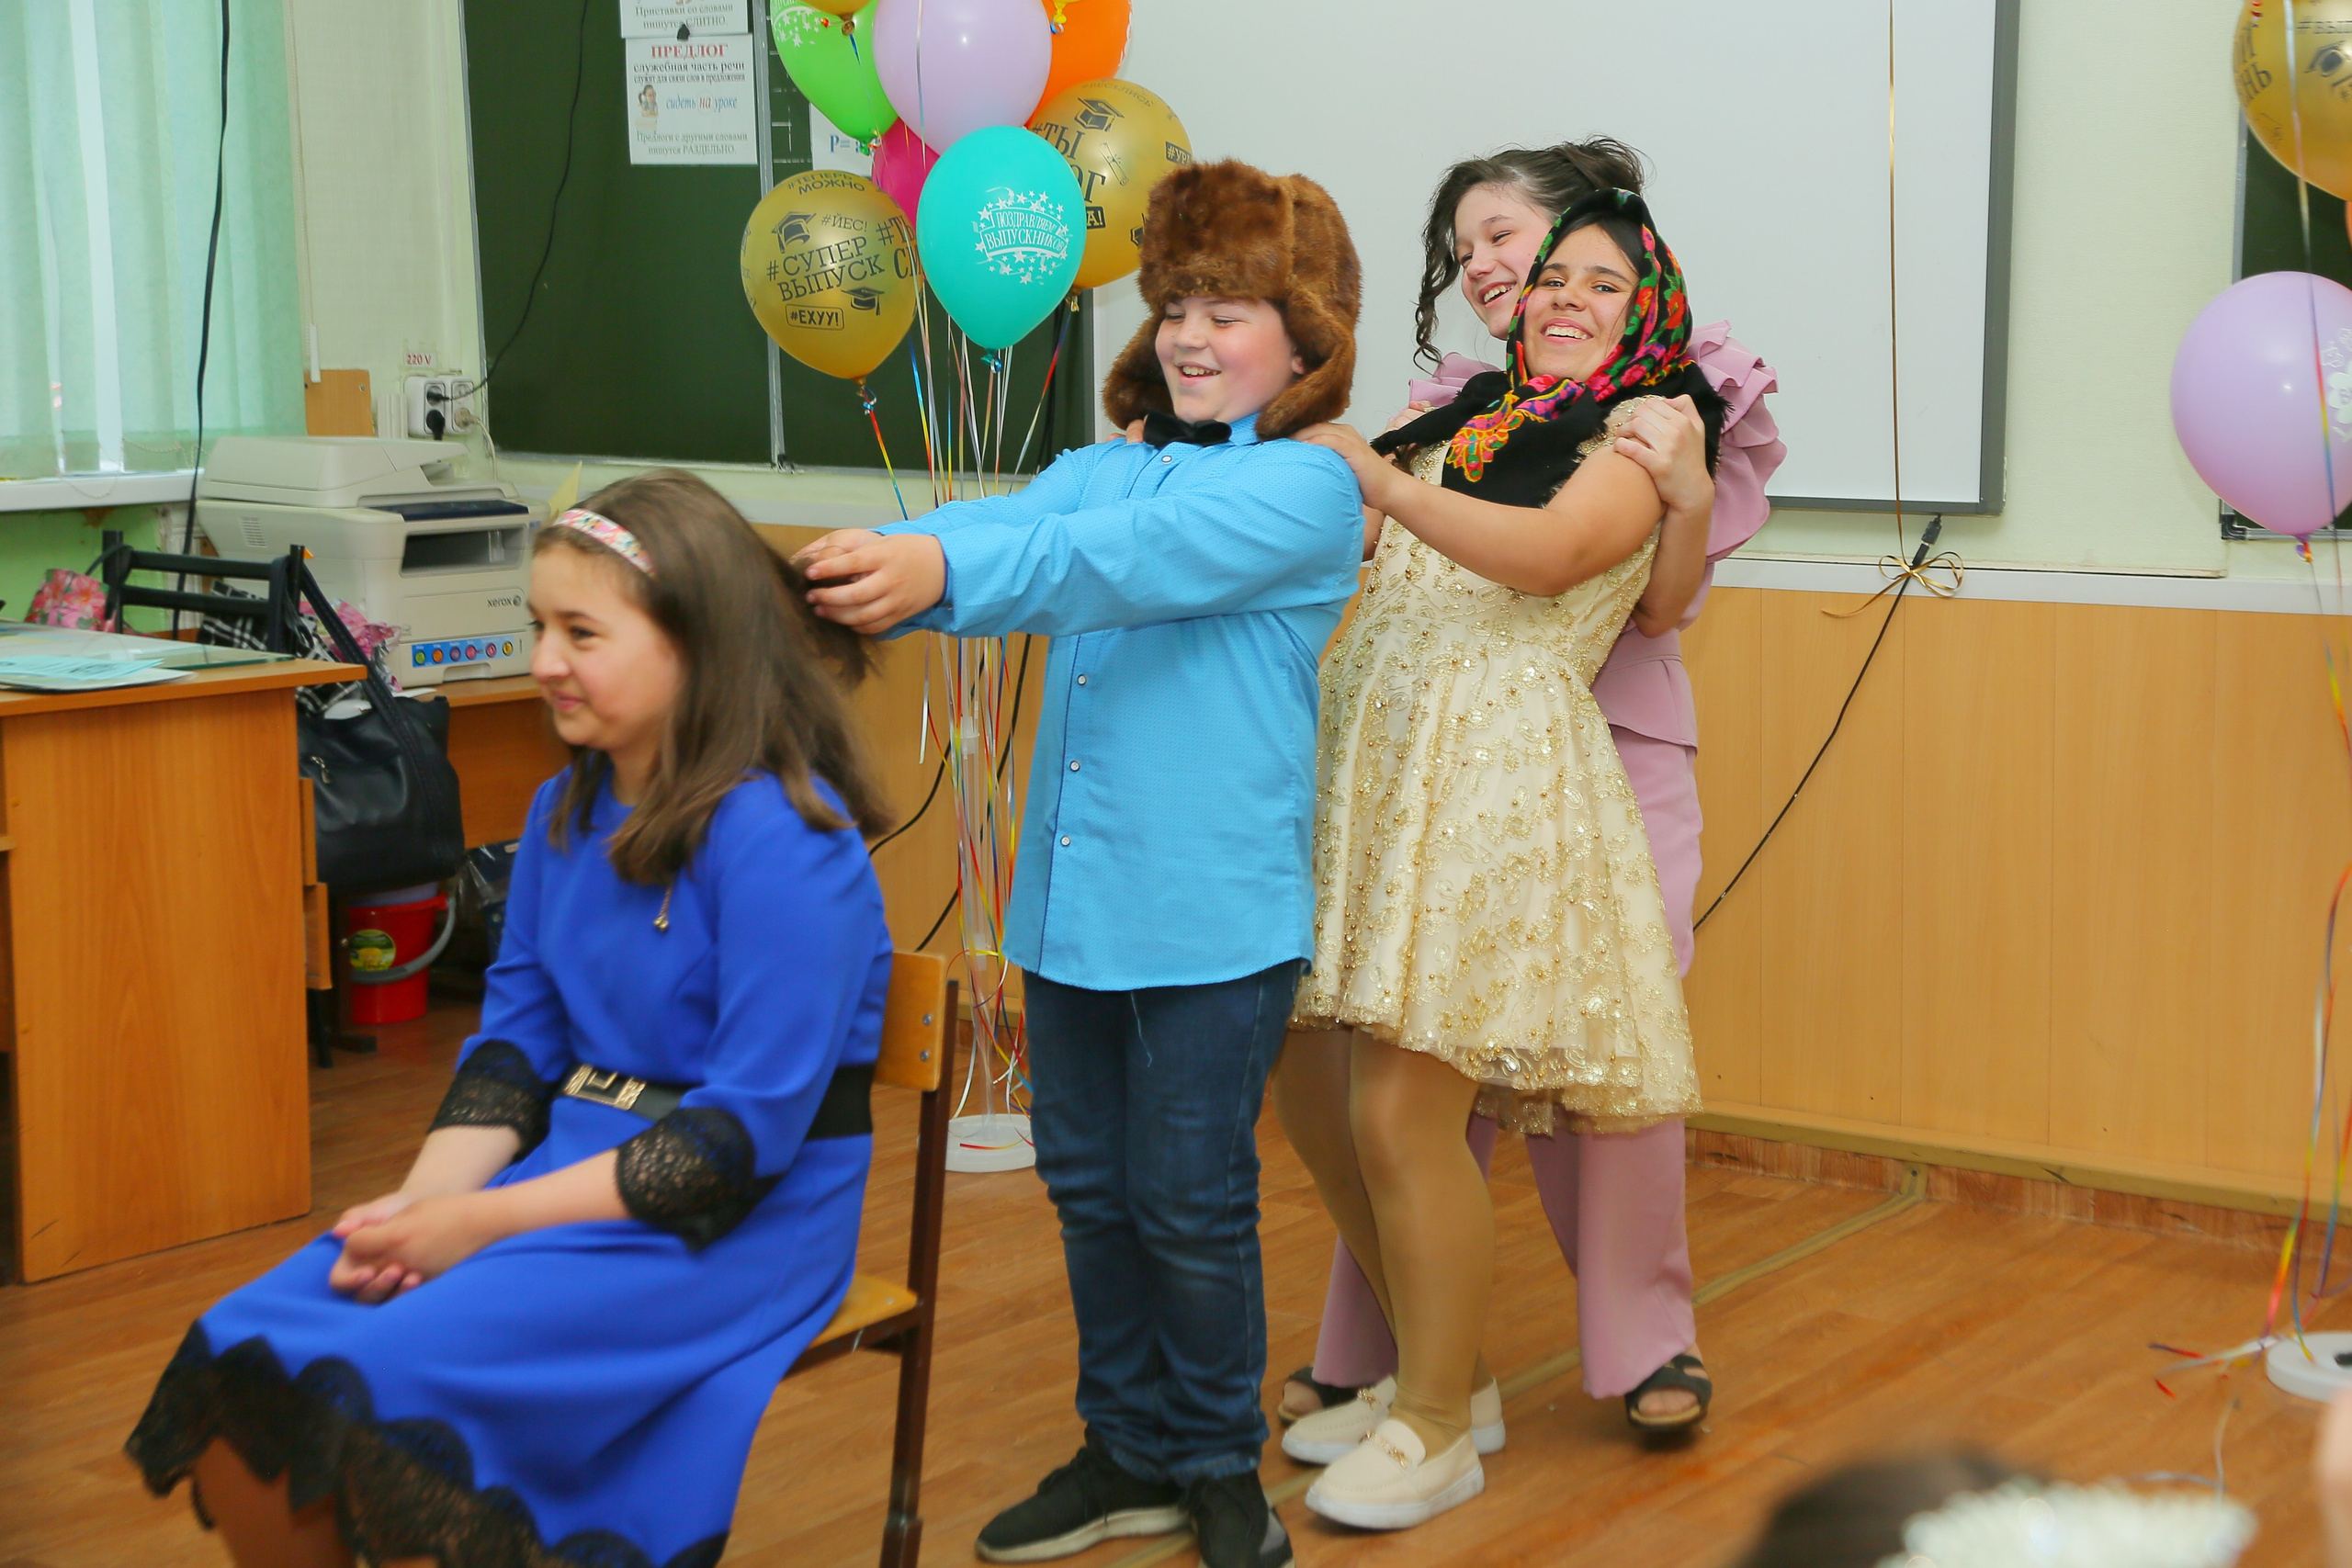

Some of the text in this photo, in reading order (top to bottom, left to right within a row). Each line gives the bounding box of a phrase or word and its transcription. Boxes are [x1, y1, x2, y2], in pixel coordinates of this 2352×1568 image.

[636, 6, 685, 17] Приставки
[699, 5, 733, 13] словами
[651, 44, 729, 61] ПРЕДЛОГ
[633, 61, 745, 74] служебная часть речи
[666, 94, 738, 113] сидеть на уроке
[637, 130, 673, 144] Предлоги
[682, 133, 714, 143] другими
[715, 132, 748, 141] словами
[648, 146, 681, 156] пишутся
[798, 179, 865, 196] МОЖНО
[820, 212, 868, 232] #ЙЕС!
[984, 228, 1065, 252] ВЫПУСКНИКОВ
[766, 235, 867, 281] #СУПЕР
[777, 254, 886, 302] ВЫПУСК
[406, 353, 423, 366] 220
[487, 597, 513, 608] xerox
